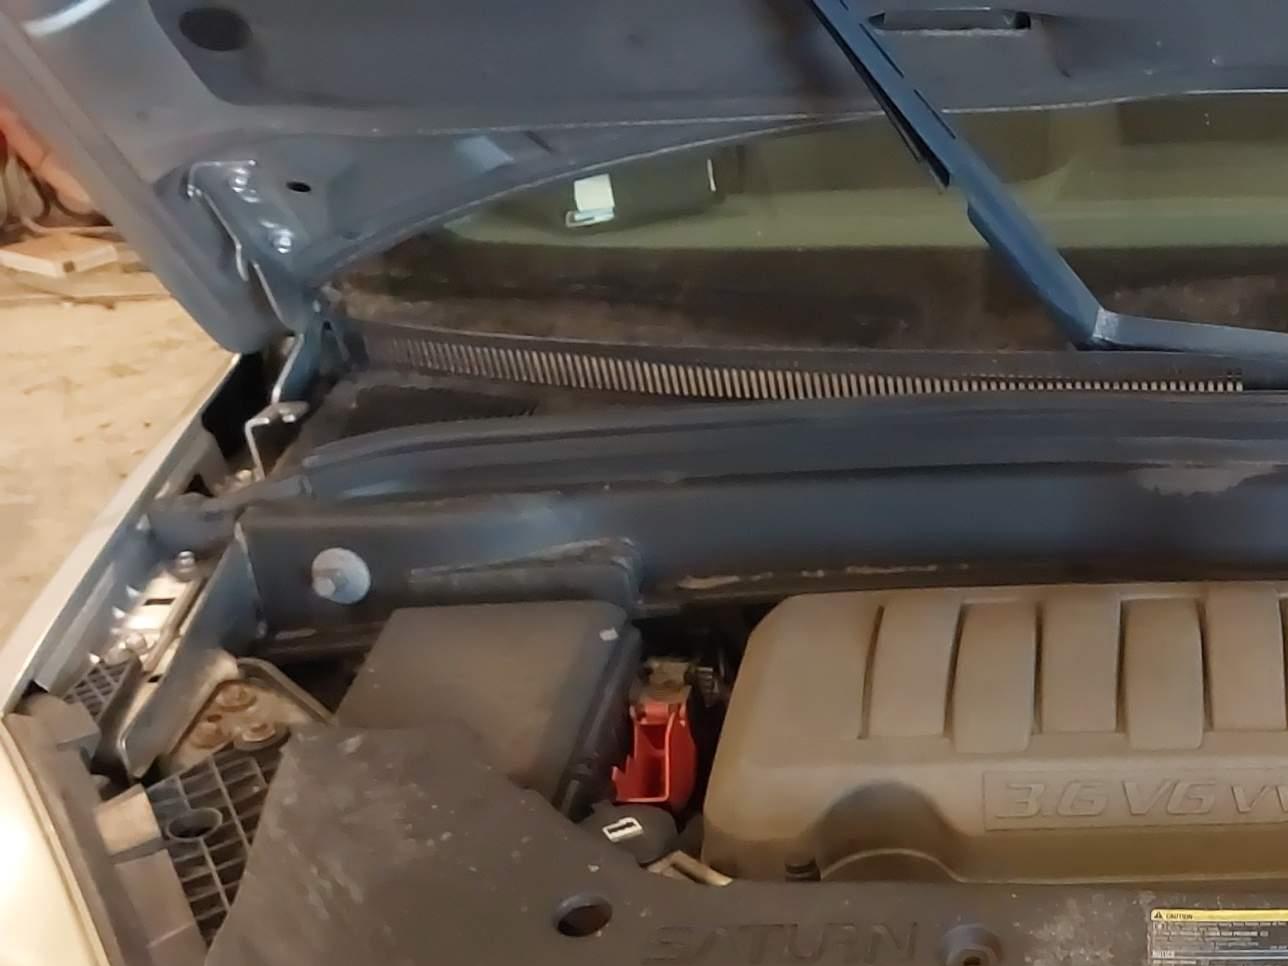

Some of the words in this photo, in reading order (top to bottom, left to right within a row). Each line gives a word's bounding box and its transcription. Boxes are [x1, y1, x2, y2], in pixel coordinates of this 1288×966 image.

[995, 781, 1107, 820] 3.6
[1121, 778, 1217, 817] V6
[1165, 912, 1193, 920] CAUTION
[640, 921, 919, 966] SATURN
